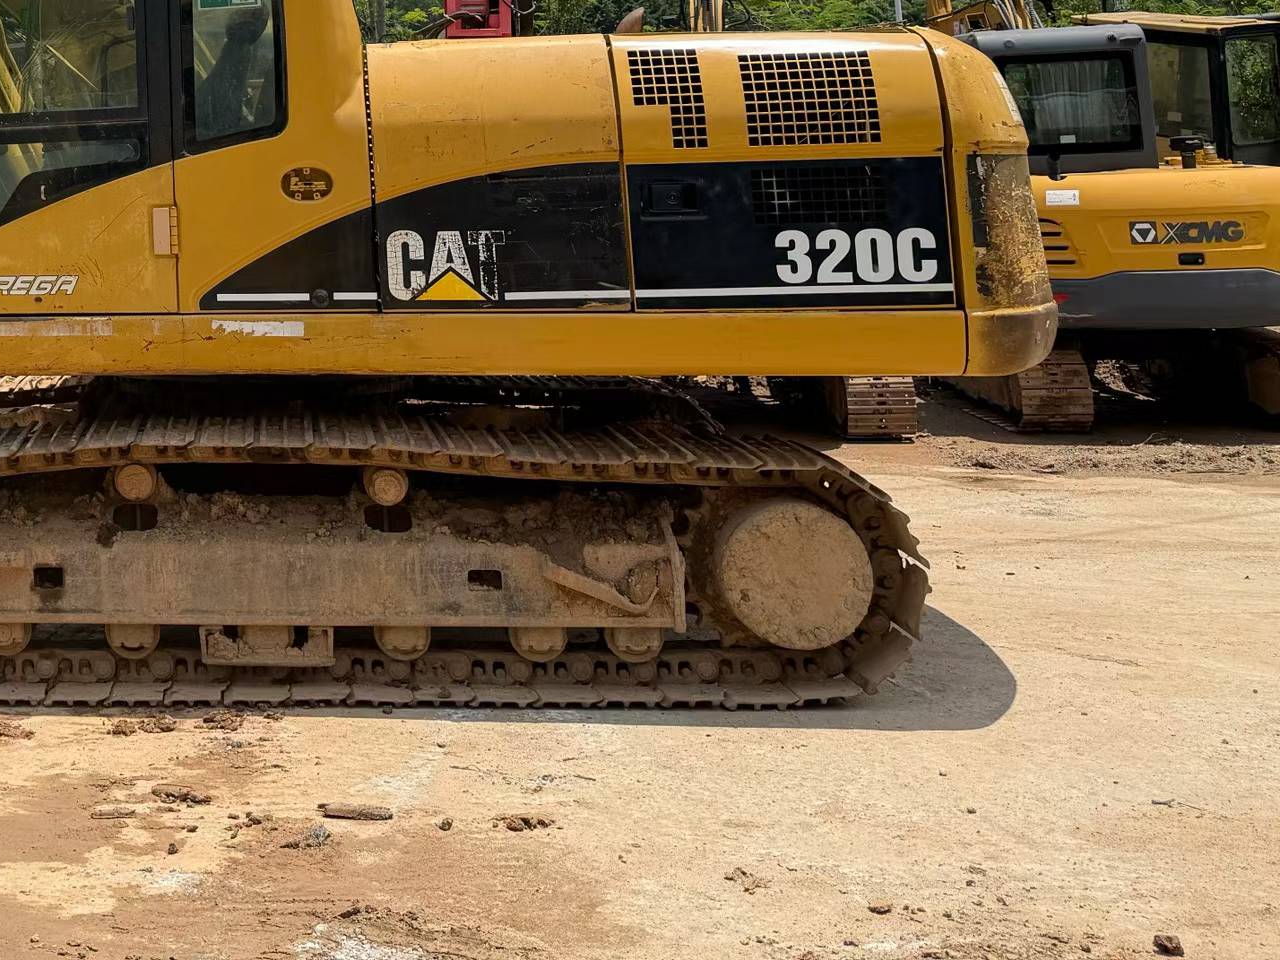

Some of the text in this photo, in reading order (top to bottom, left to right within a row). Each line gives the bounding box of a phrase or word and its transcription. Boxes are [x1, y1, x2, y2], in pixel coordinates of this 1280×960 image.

[774, 227, 939, 284] 320C
[1161, 221, 1243, 244] XCMG
[386, 230, 505, 301] CAT
